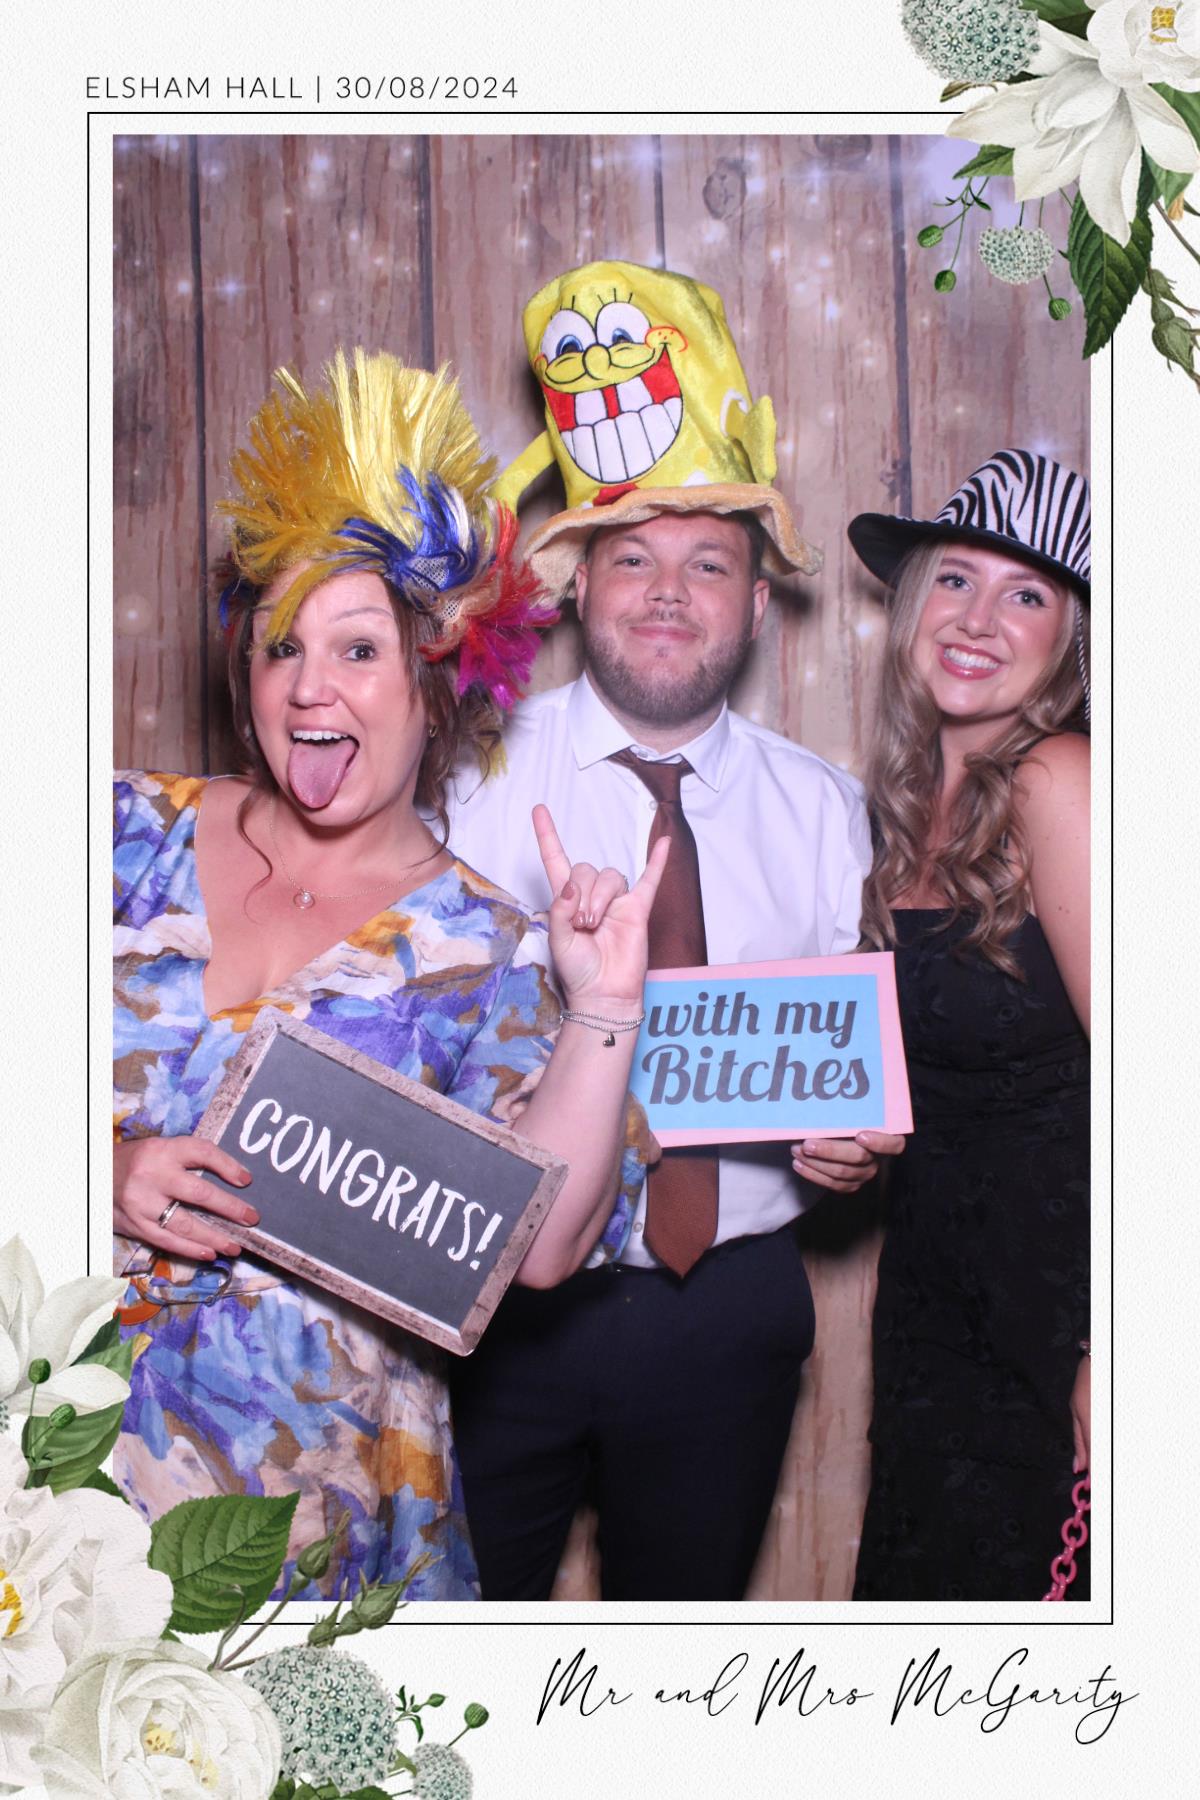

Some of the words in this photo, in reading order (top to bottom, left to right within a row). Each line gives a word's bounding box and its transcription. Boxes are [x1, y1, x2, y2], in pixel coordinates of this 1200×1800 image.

[647, 991, 761, 1038] with
[774, 1000, 857, 1049] my
[641, 1043, 870, 1105] Bitches
[239, 1098, 503, 1271] CONGRATS!
